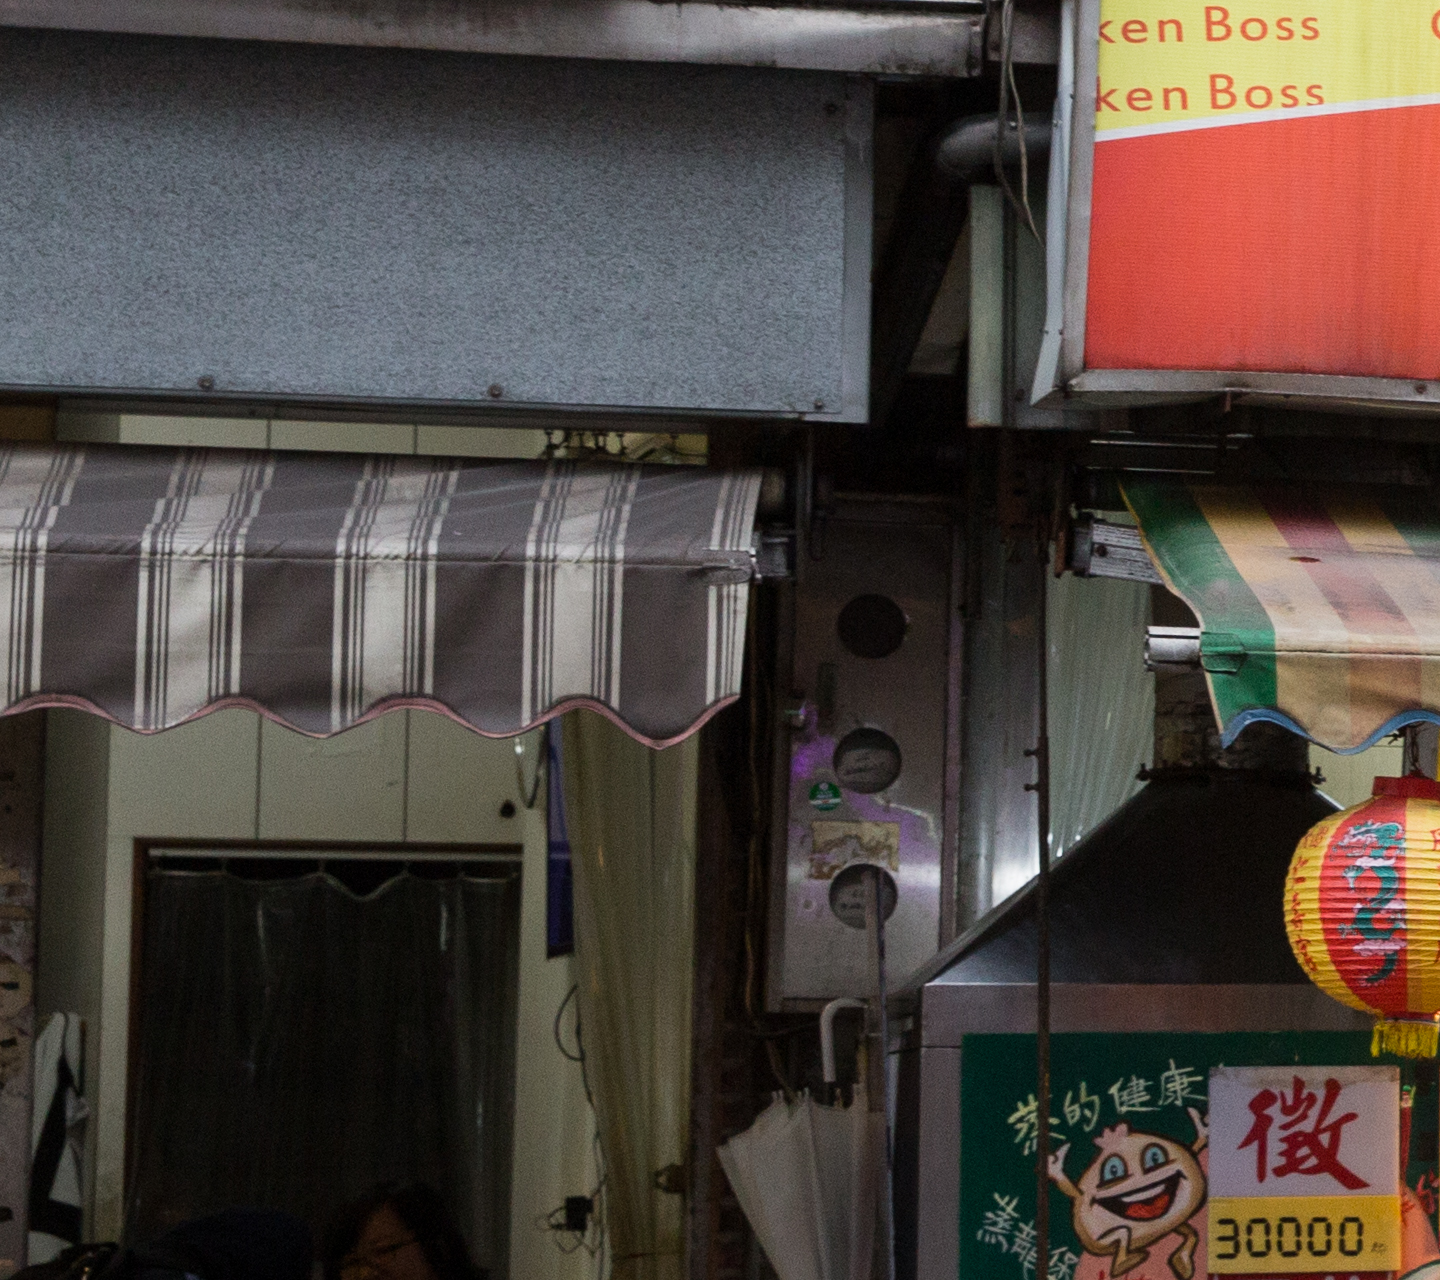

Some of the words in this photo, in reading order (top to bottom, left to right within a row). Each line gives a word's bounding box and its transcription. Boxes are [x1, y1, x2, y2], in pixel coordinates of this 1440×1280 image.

[1205, 6, 1319, 42] Boss
[1209, 74, 1324, 107] Boss
[1238, 1075, 1371, 1192] 徵
[1215, 1216, 1365, 1260] 30000
